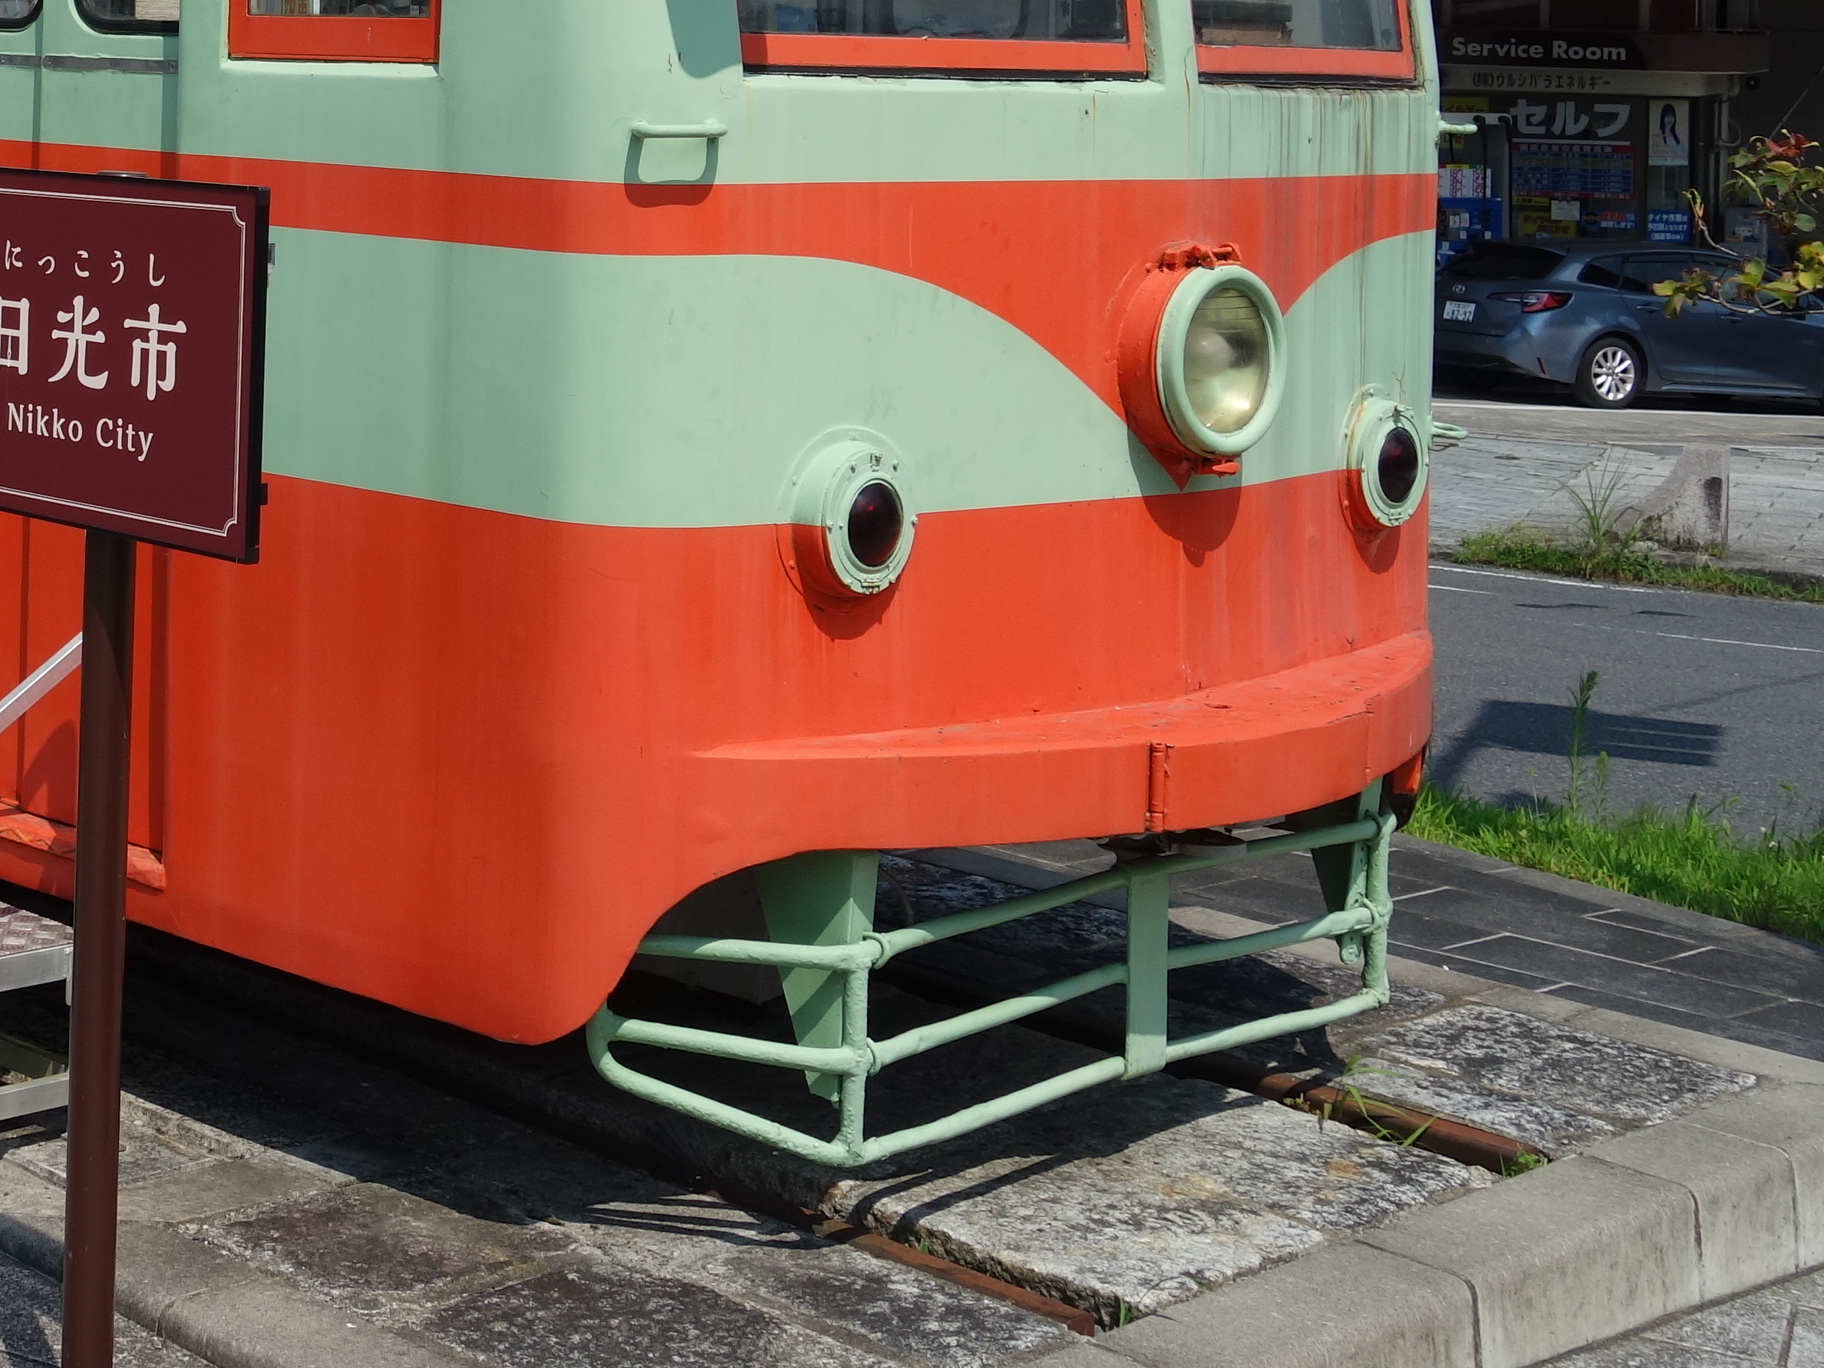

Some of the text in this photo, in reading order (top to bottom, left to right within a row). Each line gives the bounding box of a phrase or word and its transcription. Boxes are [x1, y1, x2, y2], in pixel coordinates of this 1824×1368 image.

[1451, 36, 1627, 61] Service Room
[1509, 98, 1631, 138] セルフ
[4, 239, 166, 287] にっこうし
[7, 402, 154, 462] Nikko City
